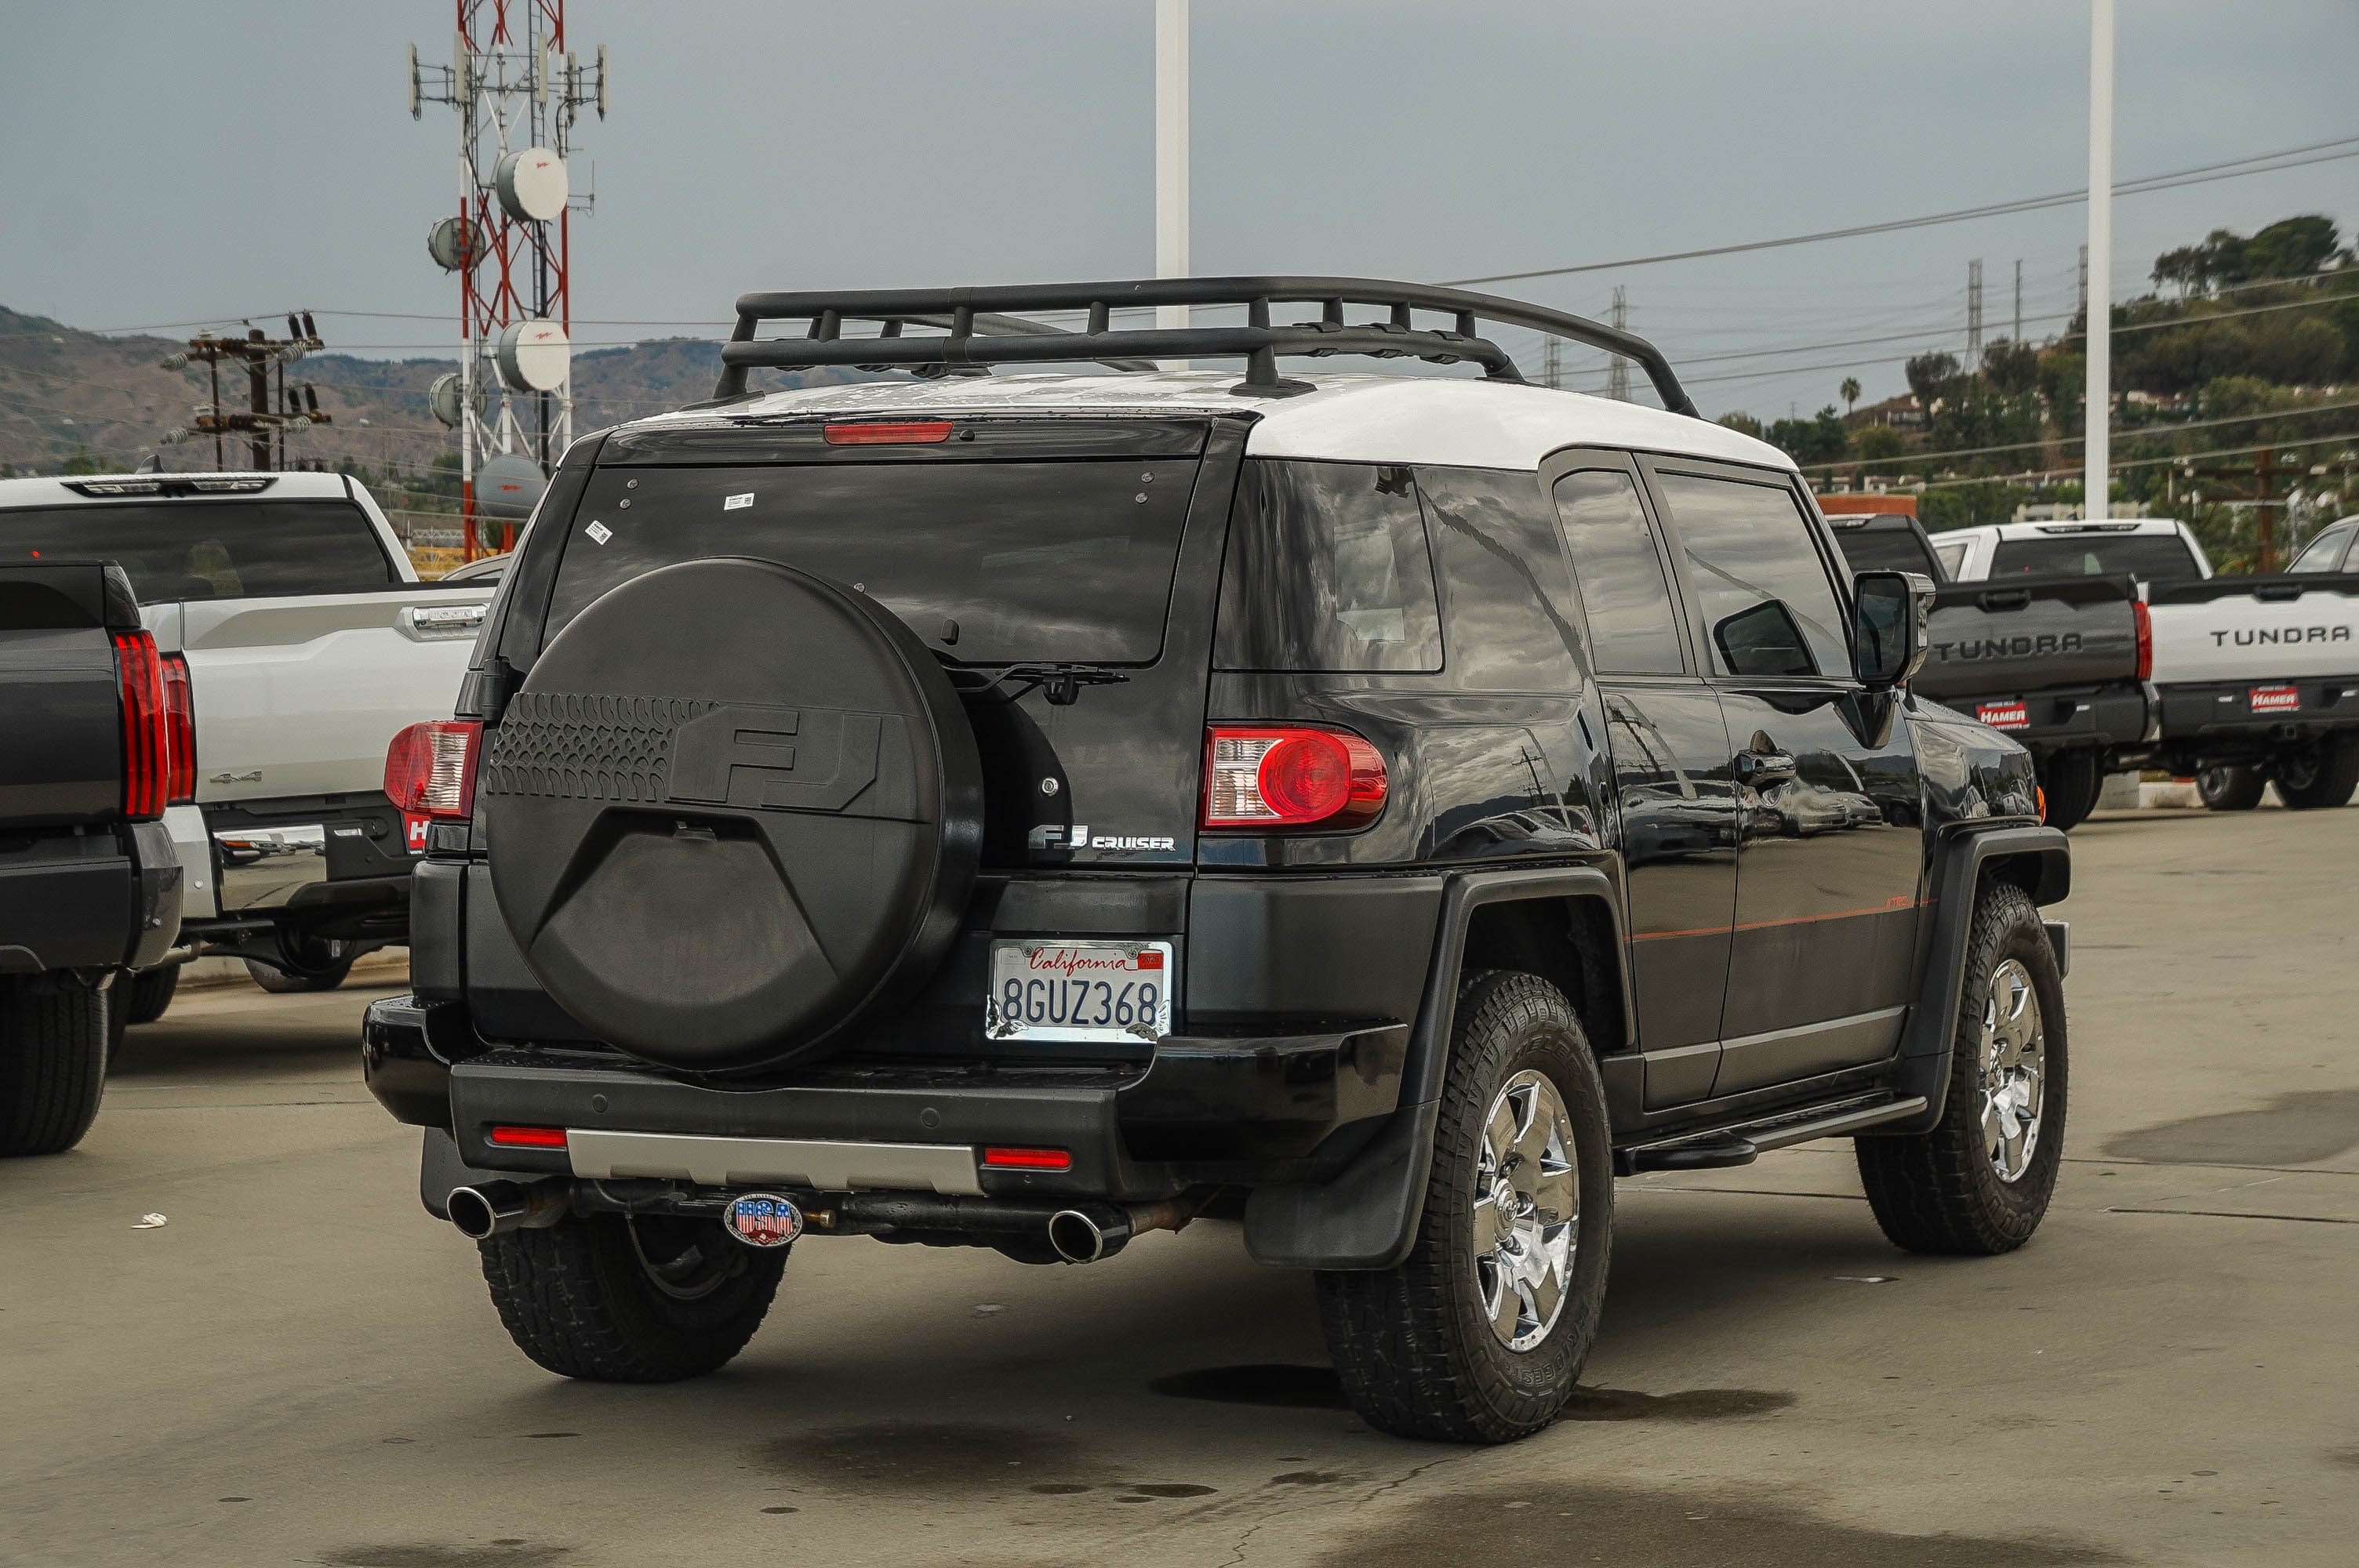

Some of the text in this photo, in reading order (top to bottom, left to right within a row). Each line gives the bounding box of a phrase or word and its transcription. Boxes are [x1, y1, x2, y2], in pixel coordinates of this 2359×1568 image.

[1933, 632, 2083, 661] TUNDRA
[2210, 626, 2350, 647] TUNDRA
[2252, 693, 2297, 706] HAMER
[1980, 710, 2026, 723] HAMER
[669, 706, 882, 812] FJ
[1029, 825, 1176, 851] FJ CRUISER
[1030, 947, 1137, 977] California
[1003, 978, 1158, 1026] 8GUZ368
[736, 1200, 794, 1236] USA
